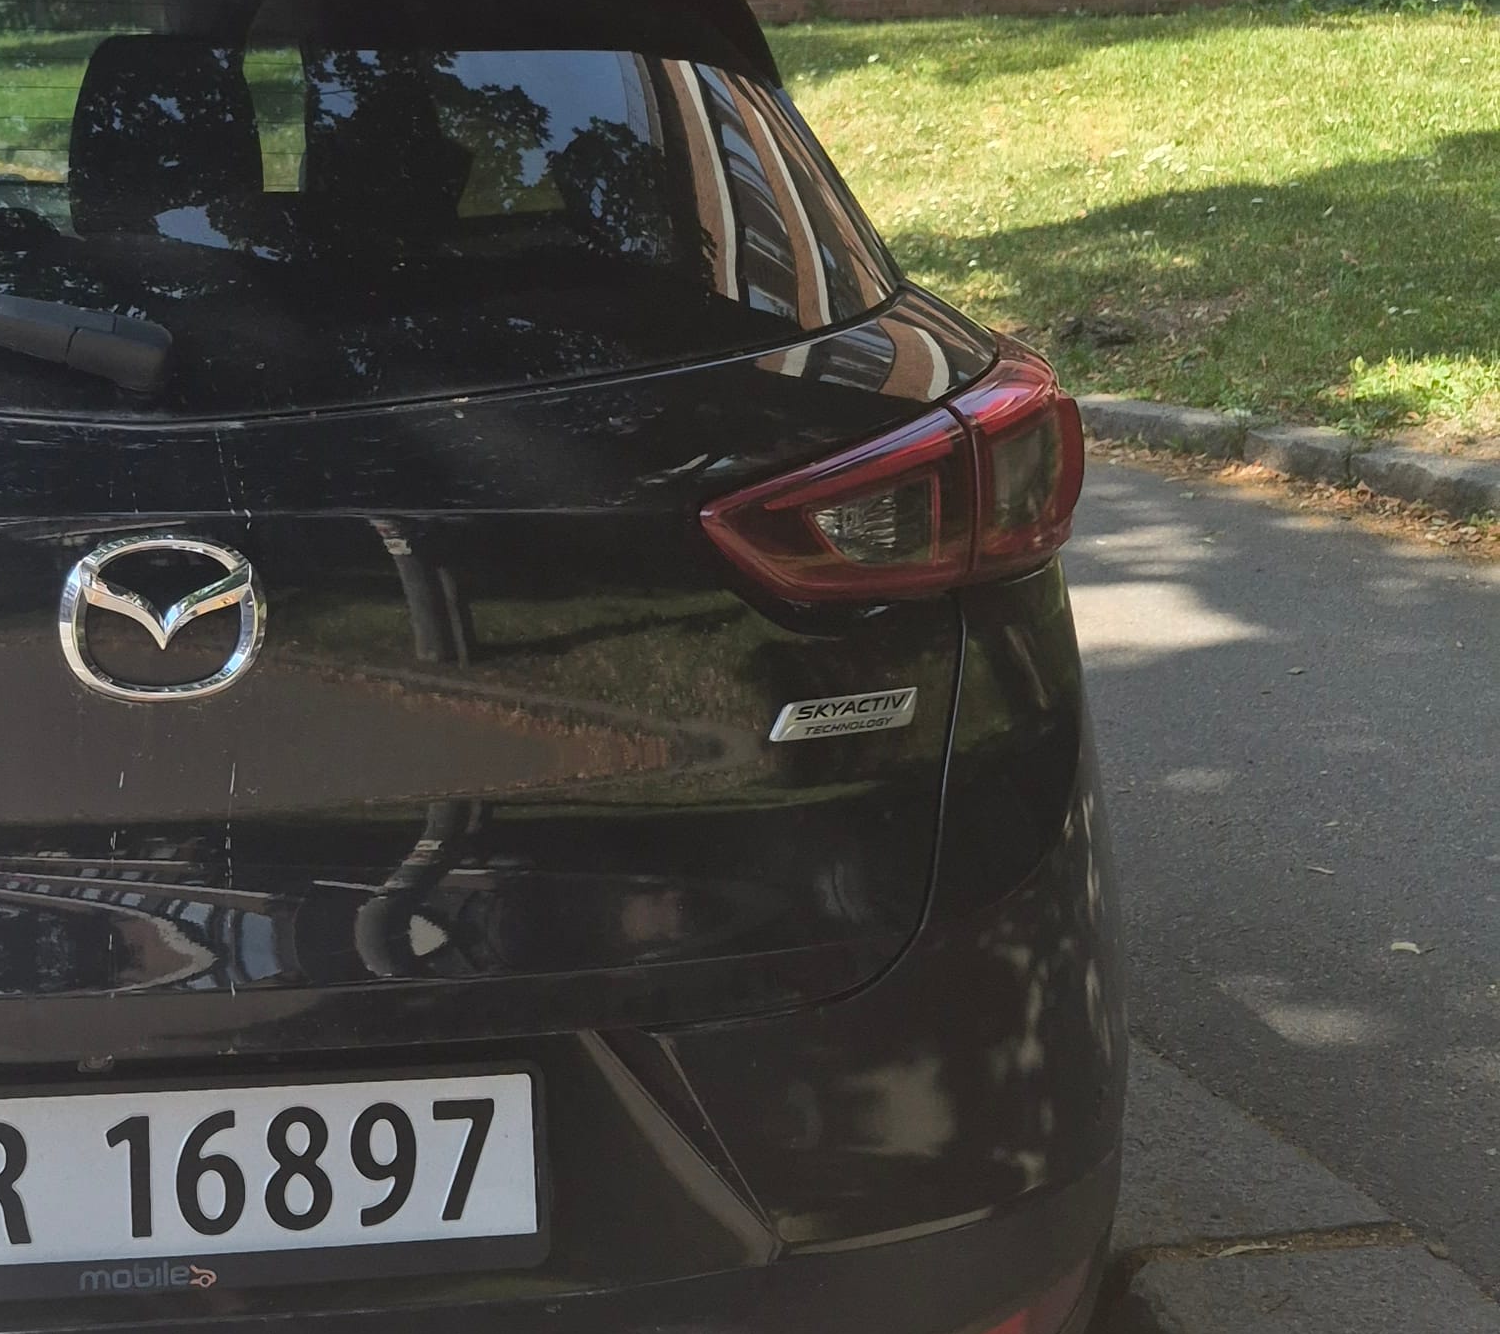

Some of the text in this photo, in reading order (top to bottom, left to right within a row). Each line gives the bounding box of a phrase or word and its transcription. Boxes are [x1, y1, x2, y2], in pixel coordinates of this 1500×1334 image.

[795, 694, 906, 720] SKYACTIV
[804, 717, 894, 736] TECHNOLOGY
[105, 1098, 497, 1240] 16897
